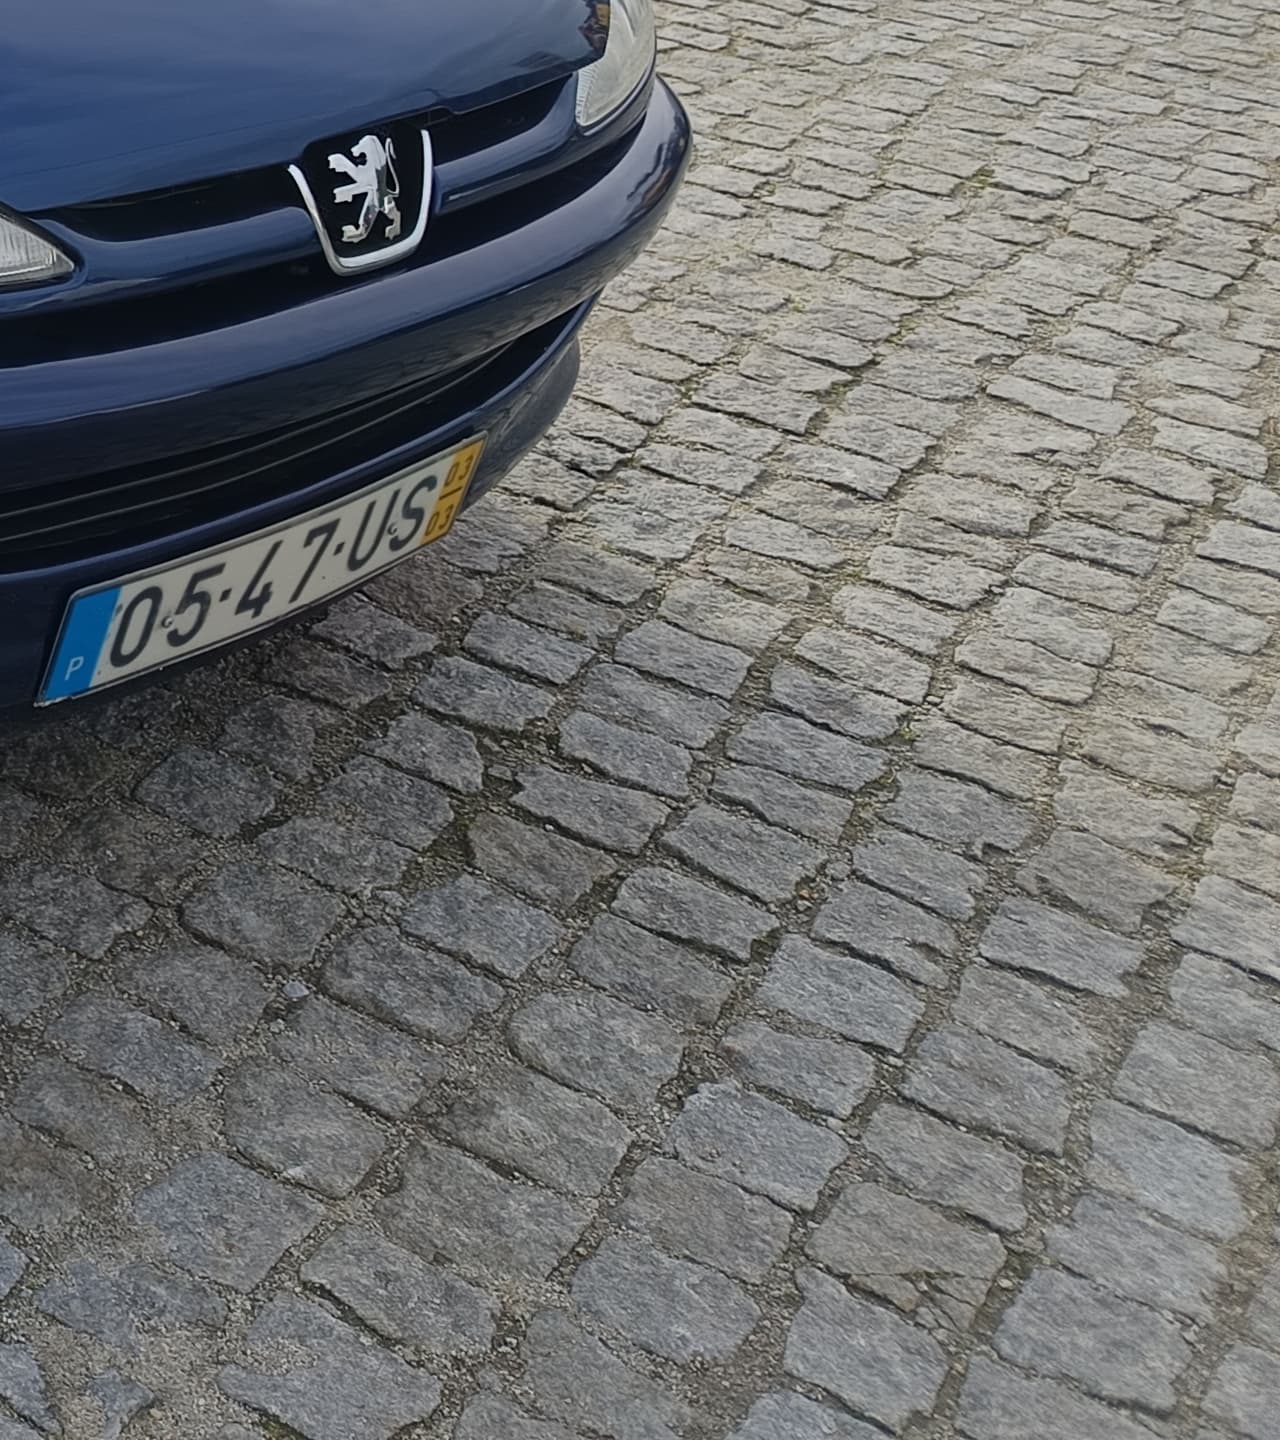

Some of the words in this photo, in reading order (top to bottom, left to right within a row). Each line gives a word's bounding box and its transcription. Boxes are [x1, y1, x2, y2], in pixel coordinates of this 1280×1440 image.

[444, 455, 474, 487] 03
[425, 504, 454, 536] 03
[65, 656, 84, 680] P
